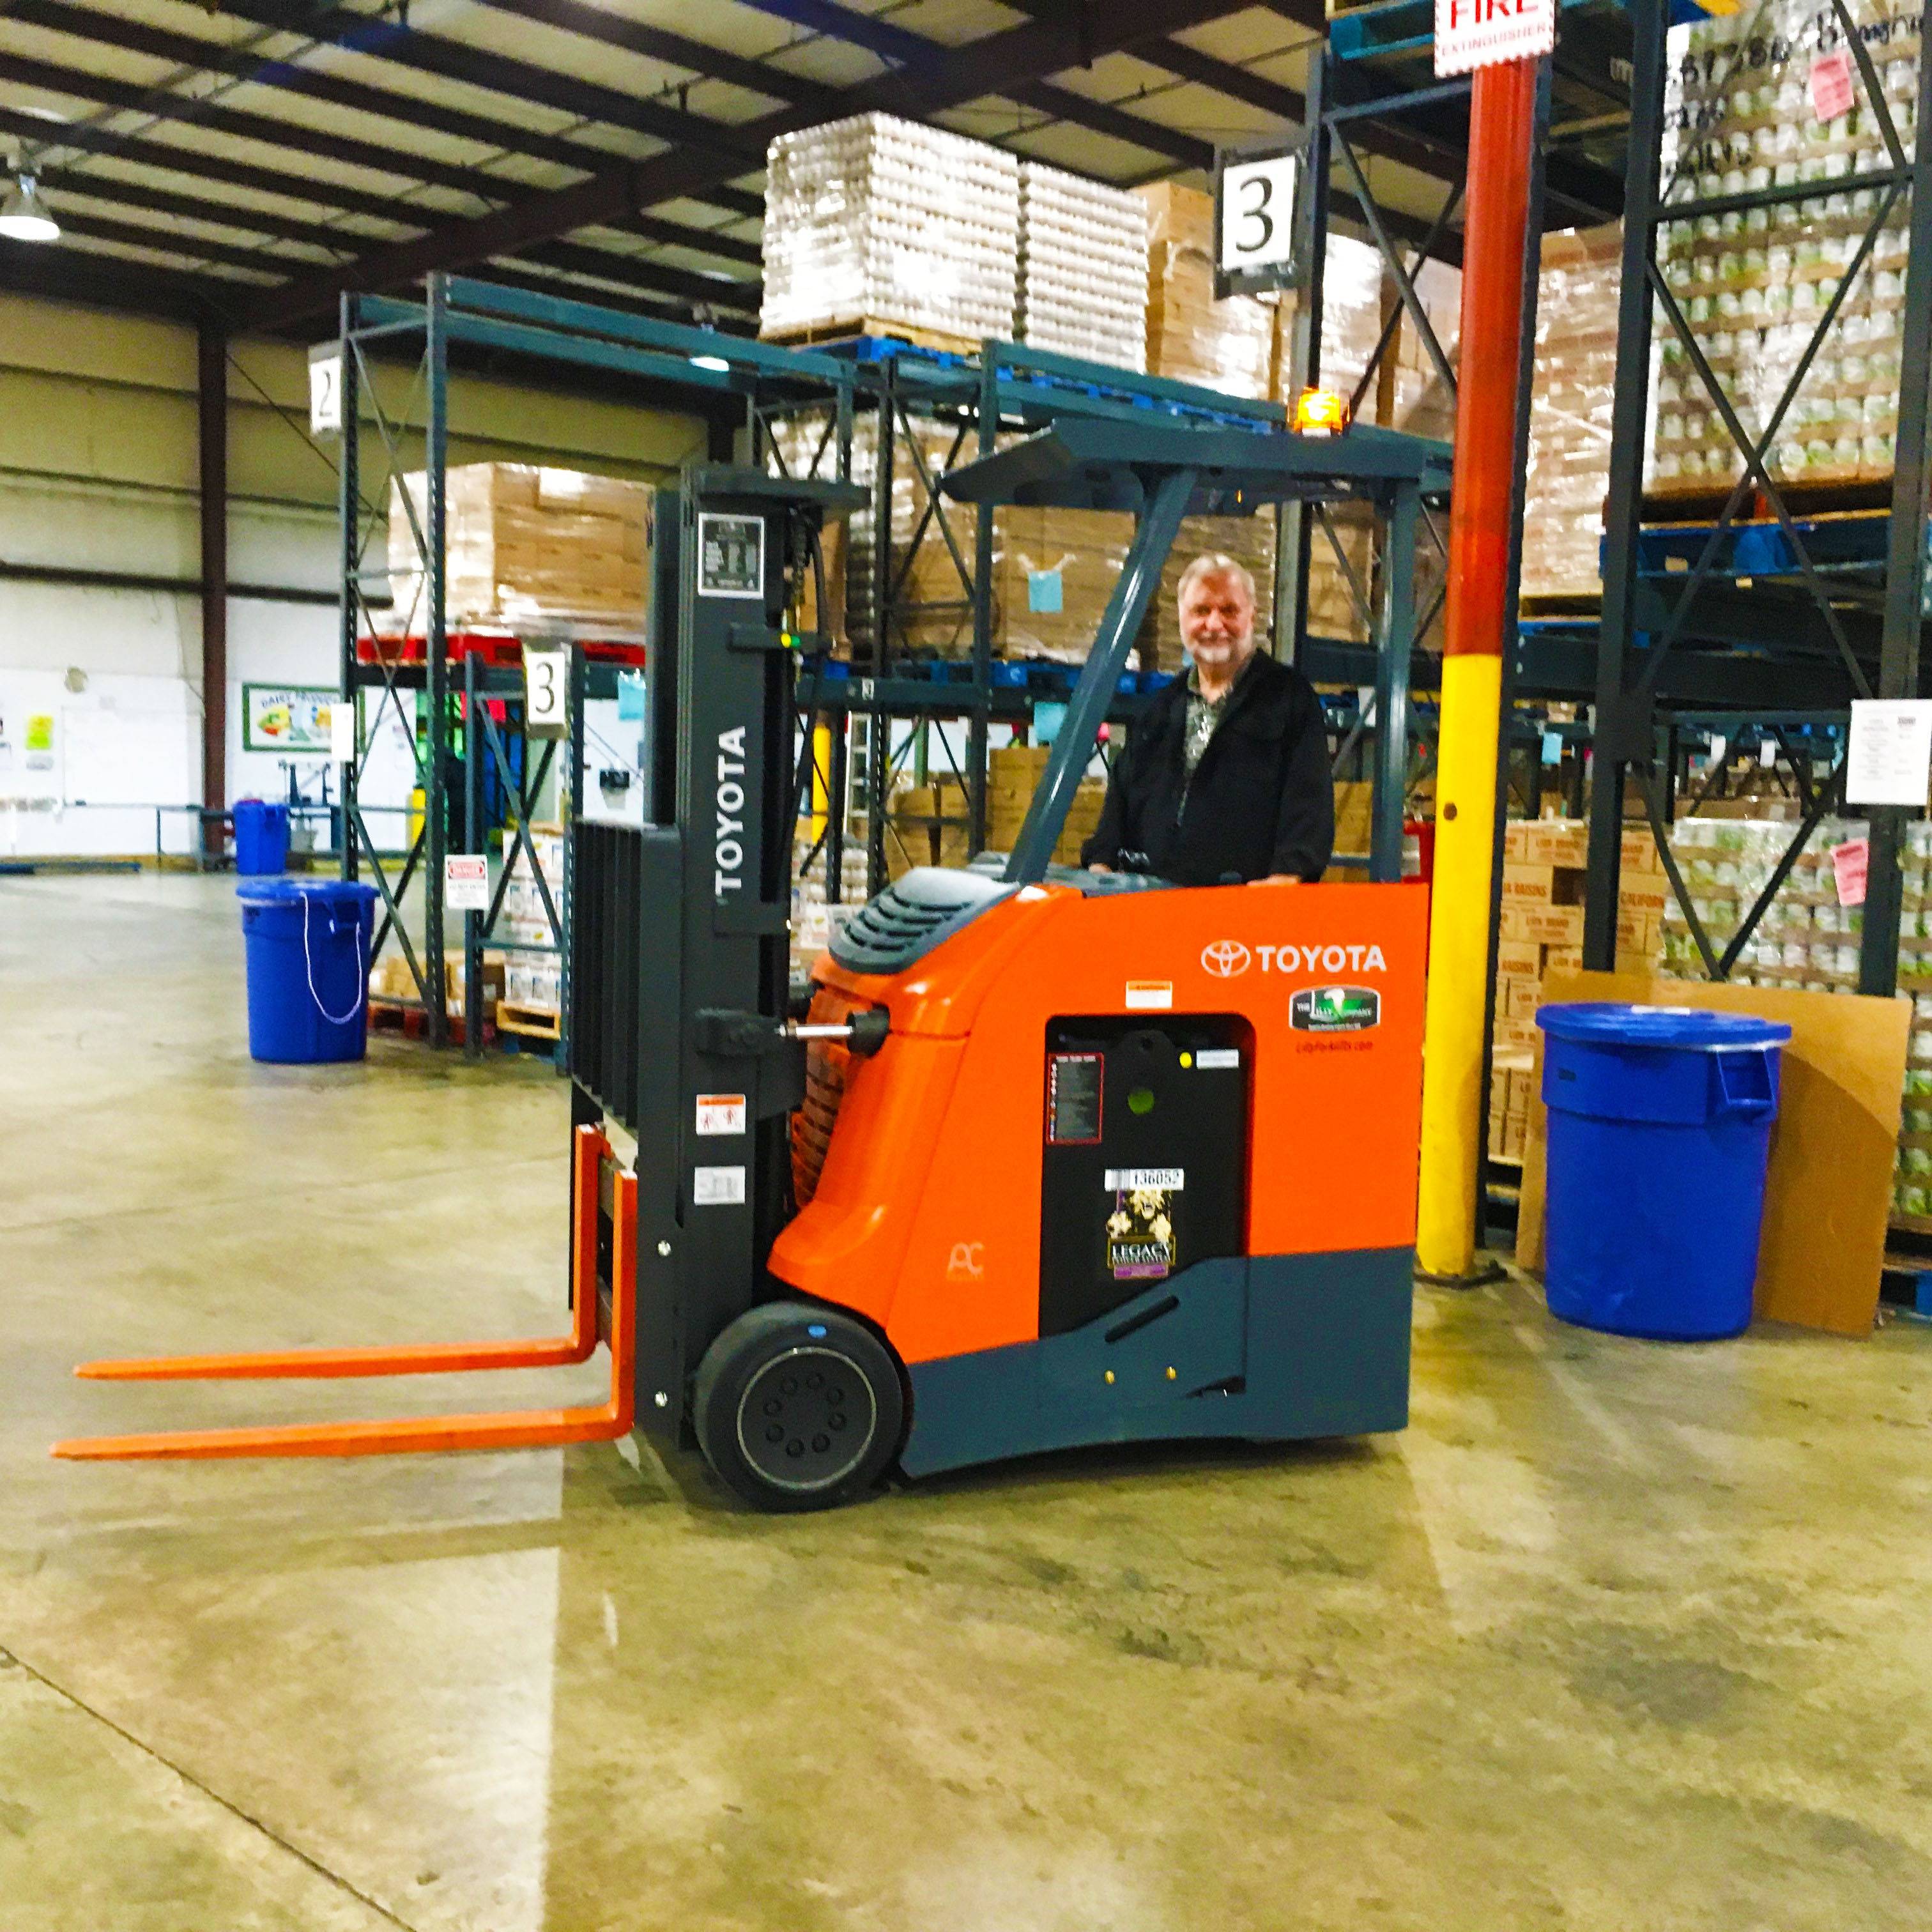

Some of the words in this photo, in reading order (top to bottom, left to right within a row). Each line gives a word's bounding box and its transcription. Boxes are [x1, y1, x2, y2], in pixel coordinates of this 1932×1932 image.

[1442, 22, 1546, 57] EXTINGUISHER
[1236, 175, 1273, 252] 3
[319, 369, 333, 417] 2
[535, 660, 555, 714] 3
[715, 726, 746, 896] TOYOTA
[1255, 944, 1388, 973] TOYOTA
[1134, 1169, 1181, 1185] 136052
